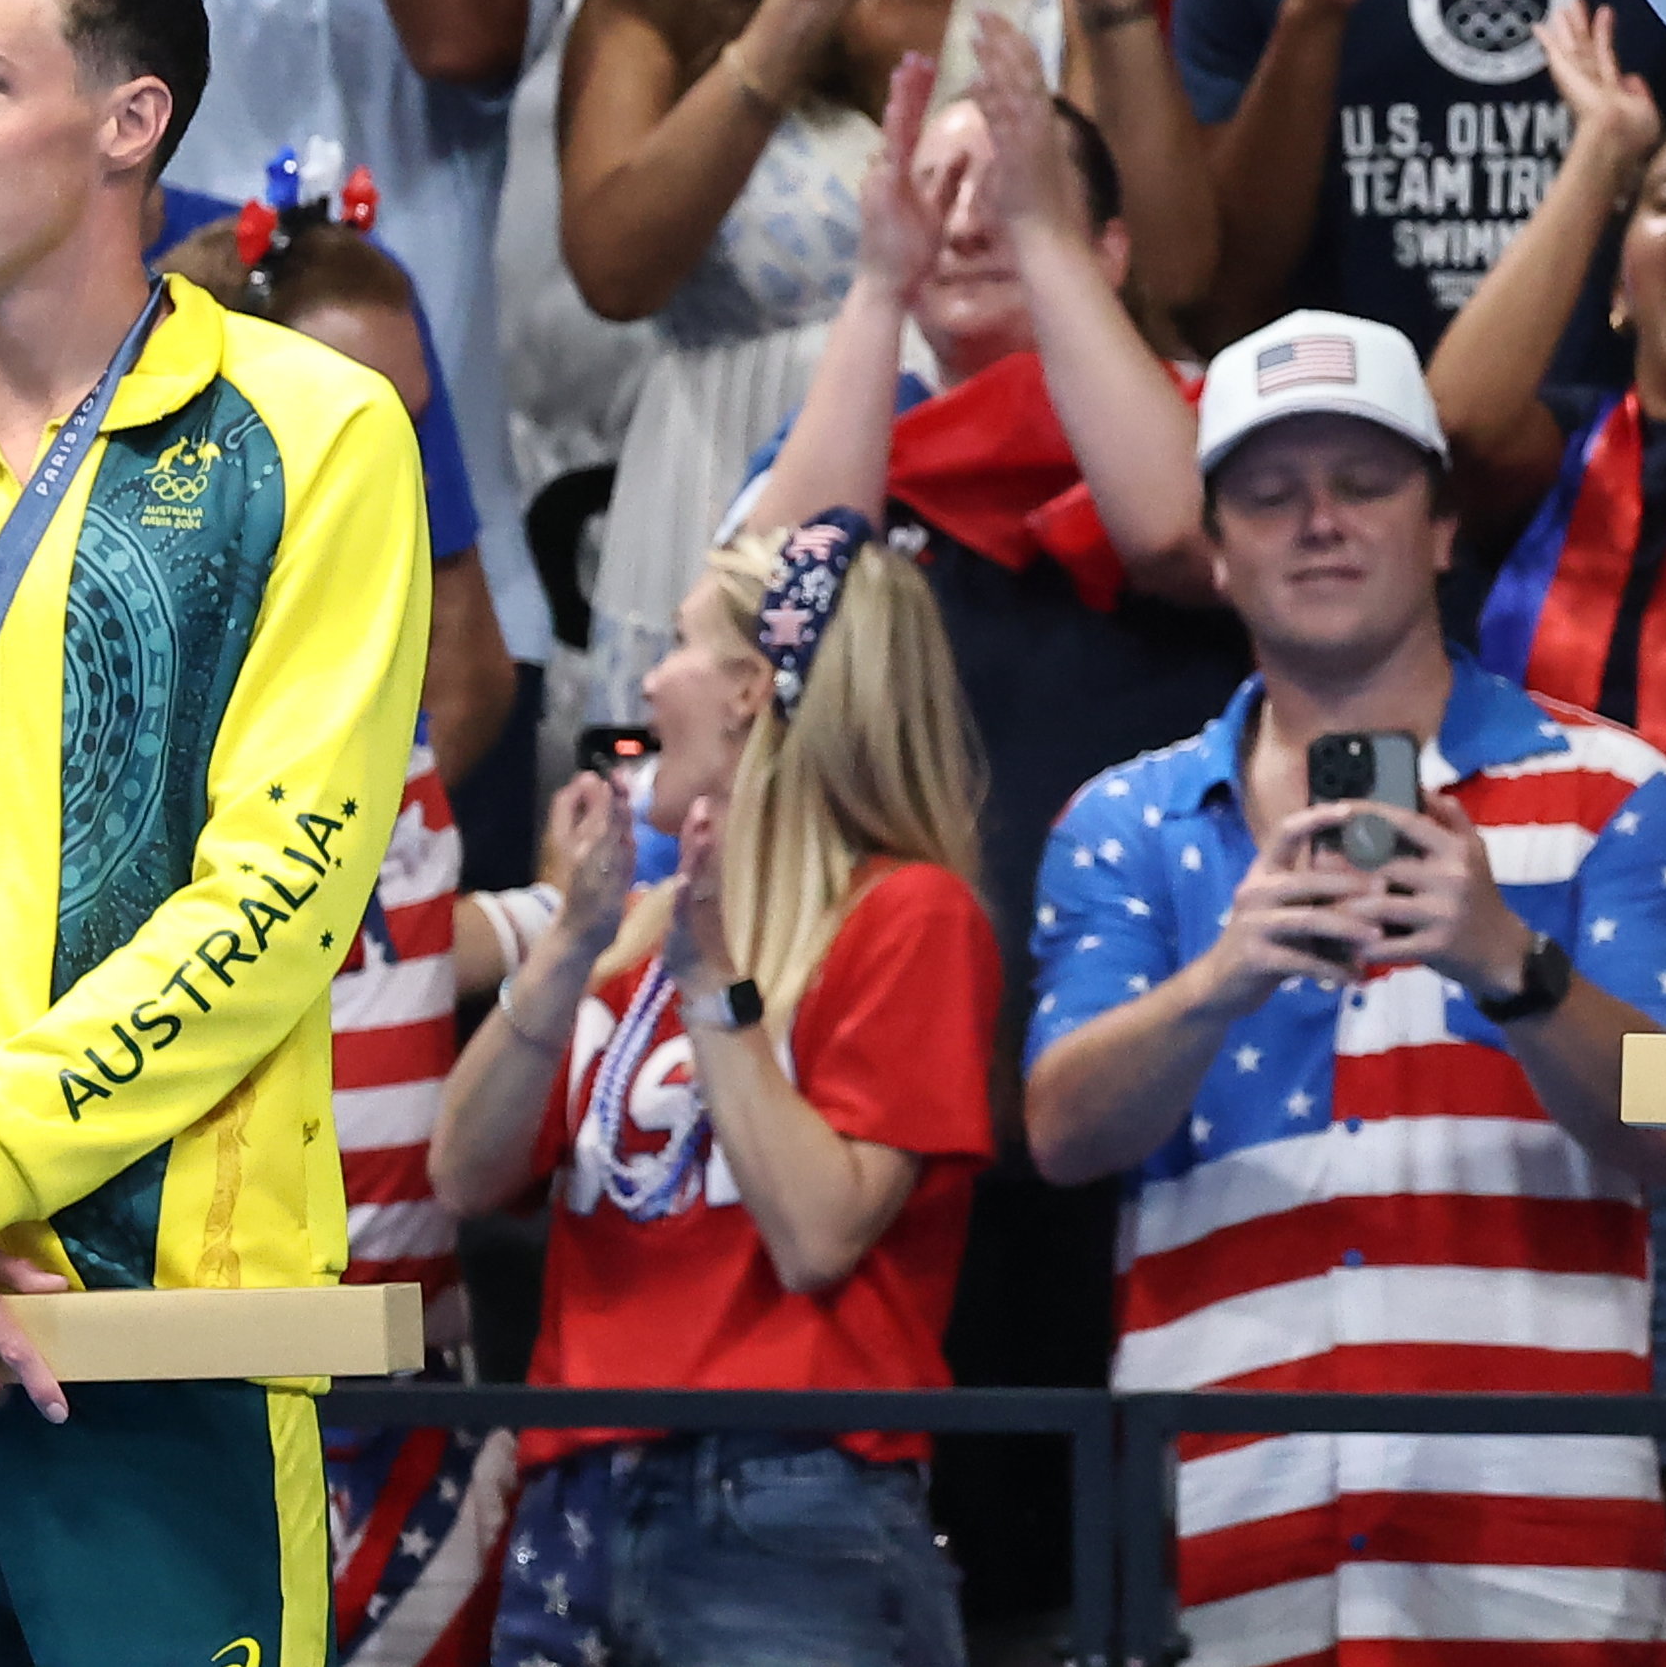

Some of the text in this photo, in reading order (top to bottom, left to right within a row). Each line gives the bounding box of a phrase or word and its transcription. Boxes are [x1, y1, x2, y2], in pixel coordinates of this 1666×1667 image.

[1344, 156, 1473, 216] TEAM
[35, 430, 78, 498] PARIS
[58, 812, 344, 1123] AUSTRALIA
